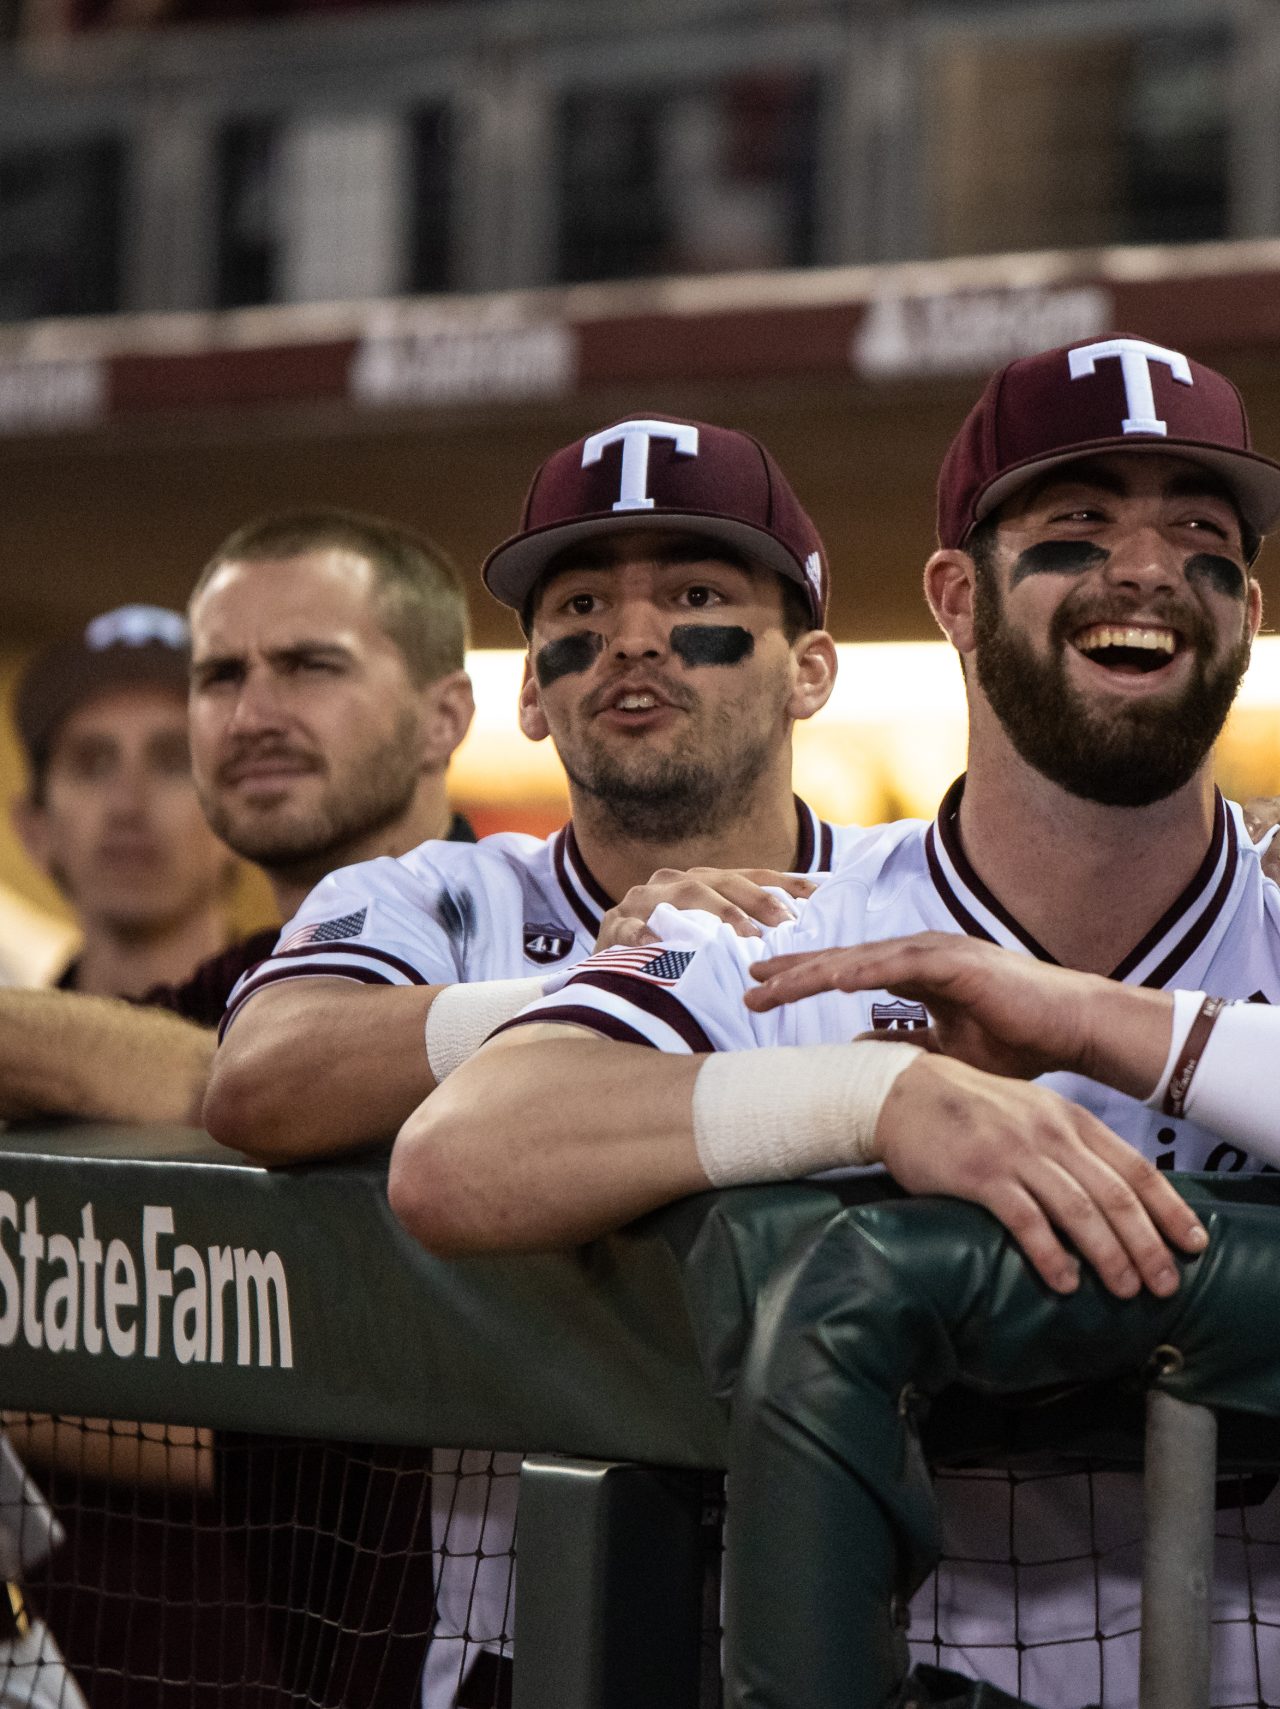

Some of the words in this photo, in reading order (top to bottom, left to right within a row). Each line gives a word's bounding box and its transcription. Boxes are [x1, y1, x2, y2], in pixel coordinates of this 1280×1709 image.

[1067, 339, 1194, 437] T
[581, 419, 698, 511] T
[526, 935, 560, 955] 41
